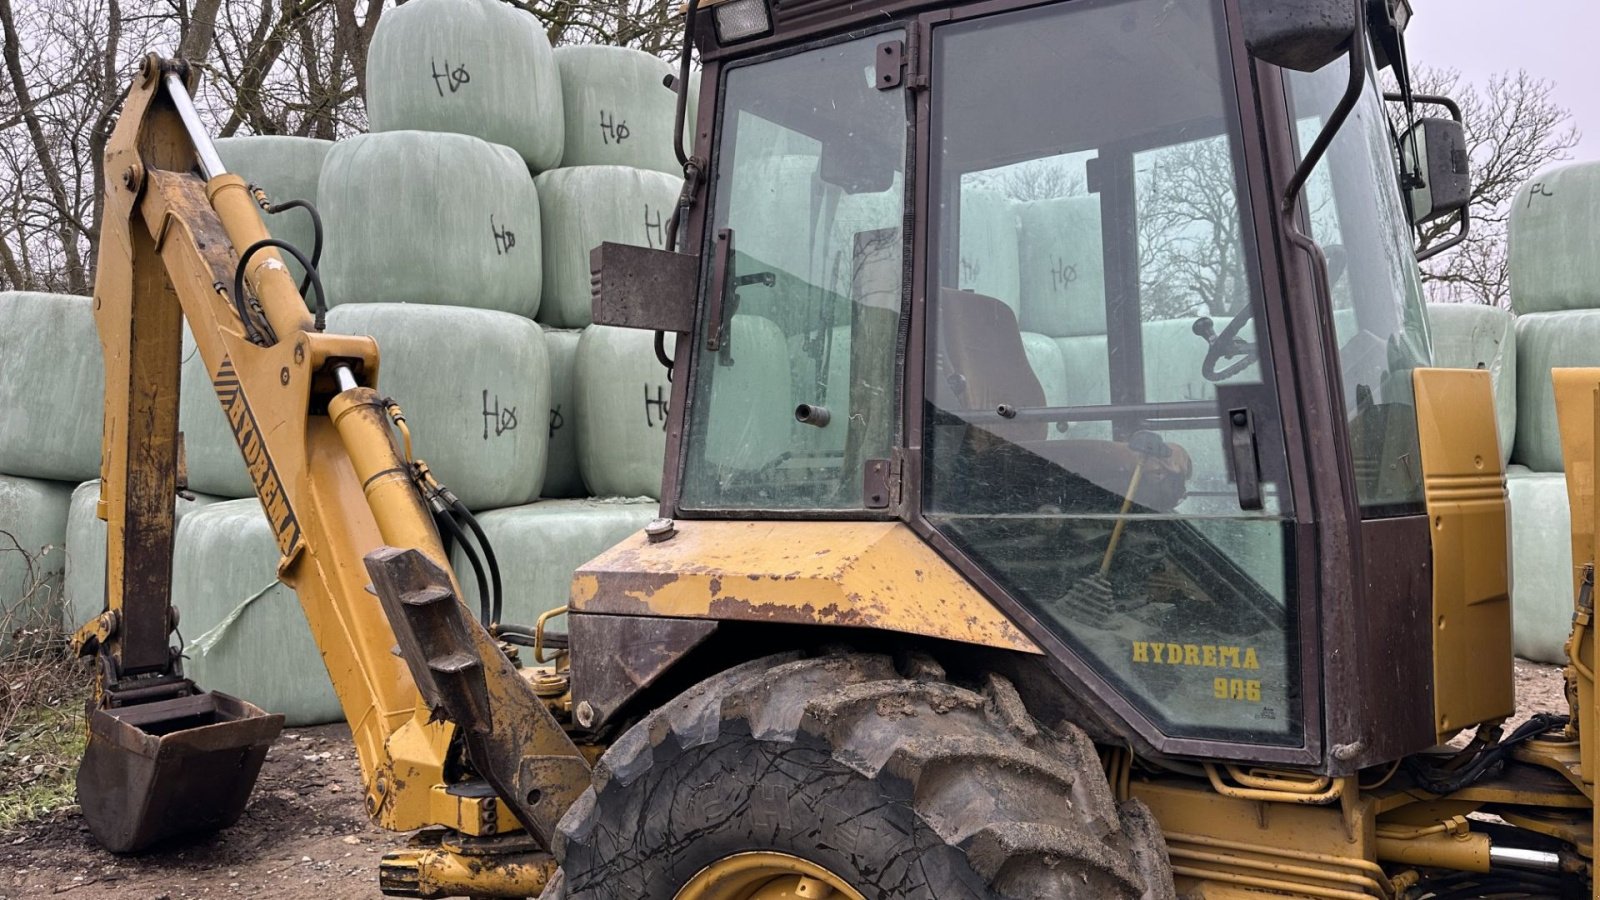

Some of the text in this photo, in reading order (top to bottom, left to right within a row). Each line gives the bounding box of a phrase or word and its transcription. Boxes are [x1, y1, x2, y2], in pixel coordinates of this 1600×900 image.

[227, 388, 298, 557] HYDREMA
[1132, 640, 1260, 670] HYDREMA
[1213, 676, 1261, 703] 906
